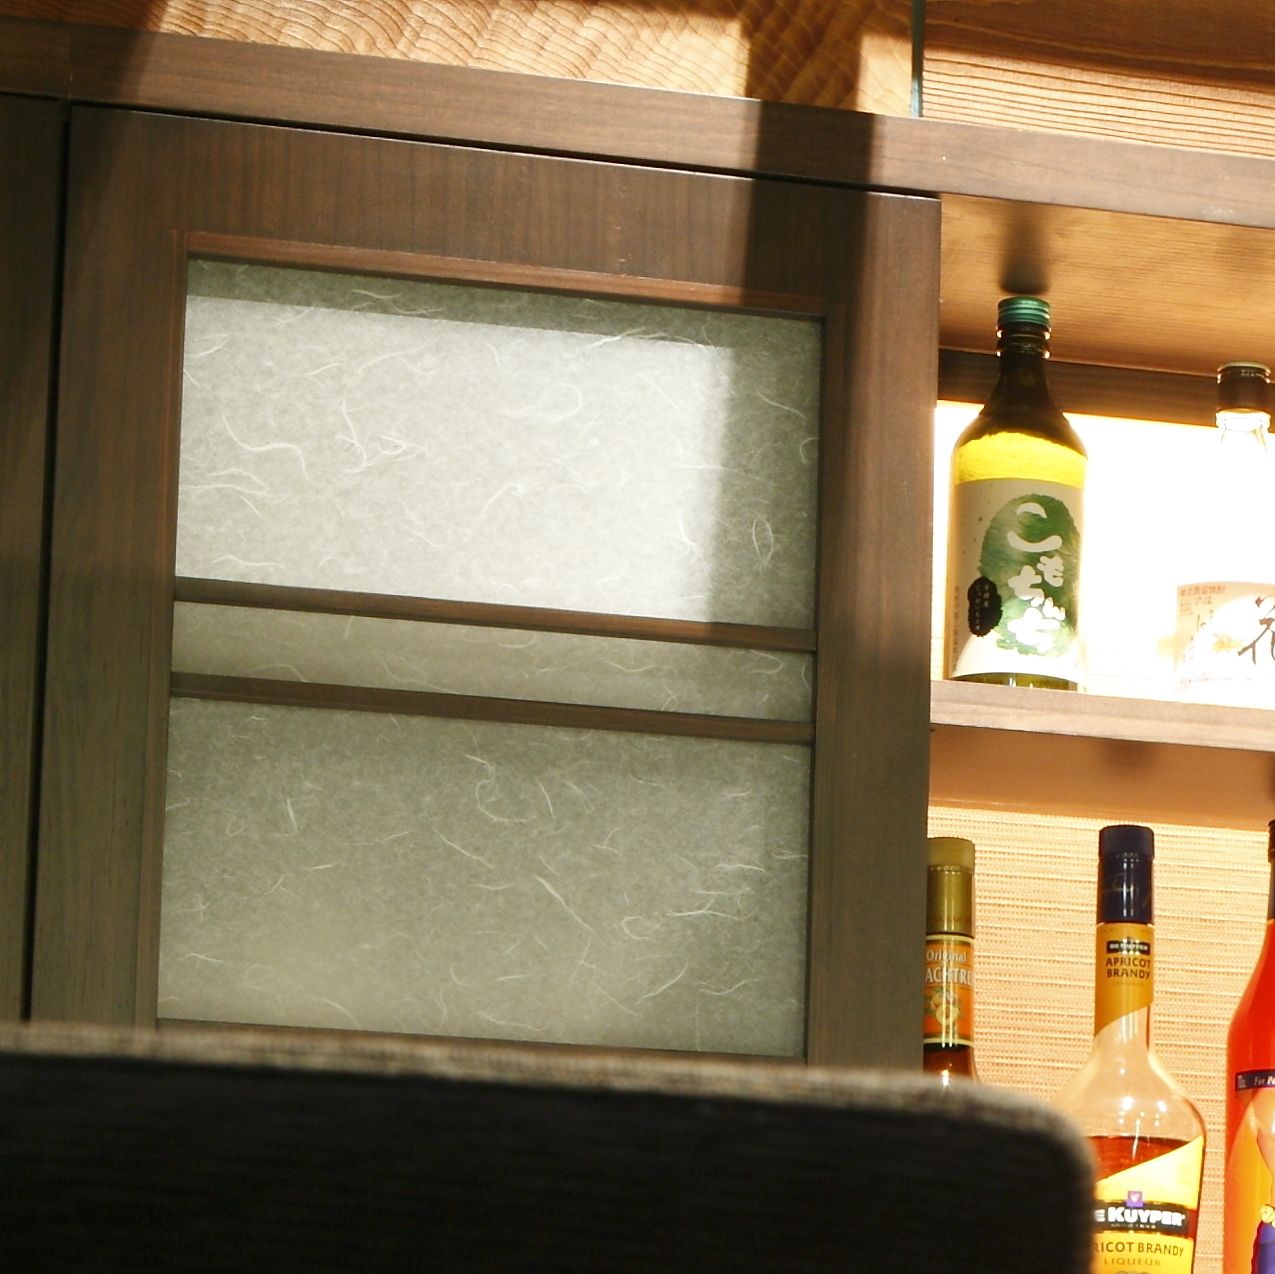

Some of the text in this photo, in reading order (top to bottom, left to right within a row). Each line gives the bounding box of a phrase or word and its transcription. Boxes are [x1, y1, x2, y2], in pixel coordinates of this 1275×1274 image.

[926, 949, 967, 964] Original
[1105, 957, 1151, 968] APRICOT
[1106, 968, 1151, 979] BRANDY
[1107, 1206, 1183, 1226] KUYPER
[1137, 1242, 1185, 1257] BRANDY
[1104, 1258, 1162, 1266] LIQUEUR
